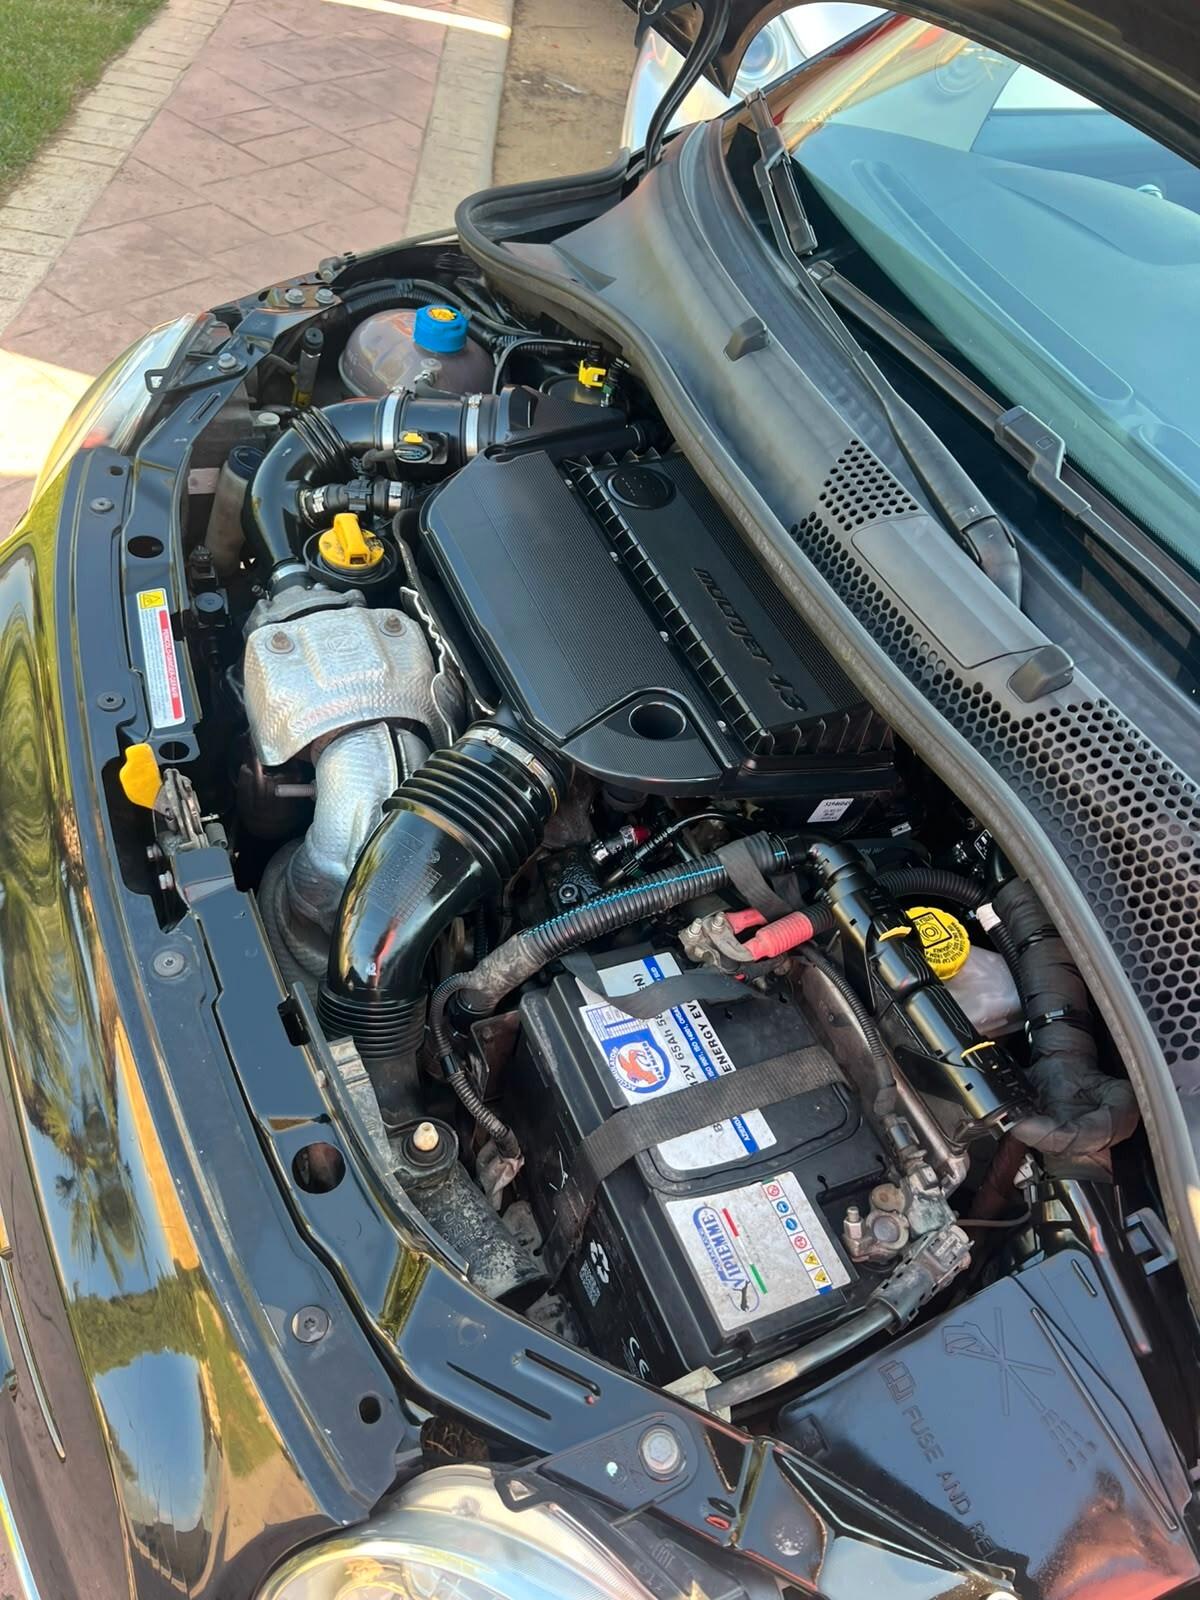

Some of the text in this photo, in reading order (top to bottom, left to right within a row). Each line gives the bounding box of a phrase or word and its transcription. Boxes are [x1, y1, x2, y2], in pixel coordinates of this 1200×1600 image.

[664, 1029, 685, 1062] 65Ah
[687, 1000, 732, 1074] ENERGY EV
[681, 1064, 699, 1086] 12V
[701, 1213, 746, 1288] VIPIEMME
[902, 1404, 945, 1464] FUSE
[936, 1471, 972, 1516] AND
